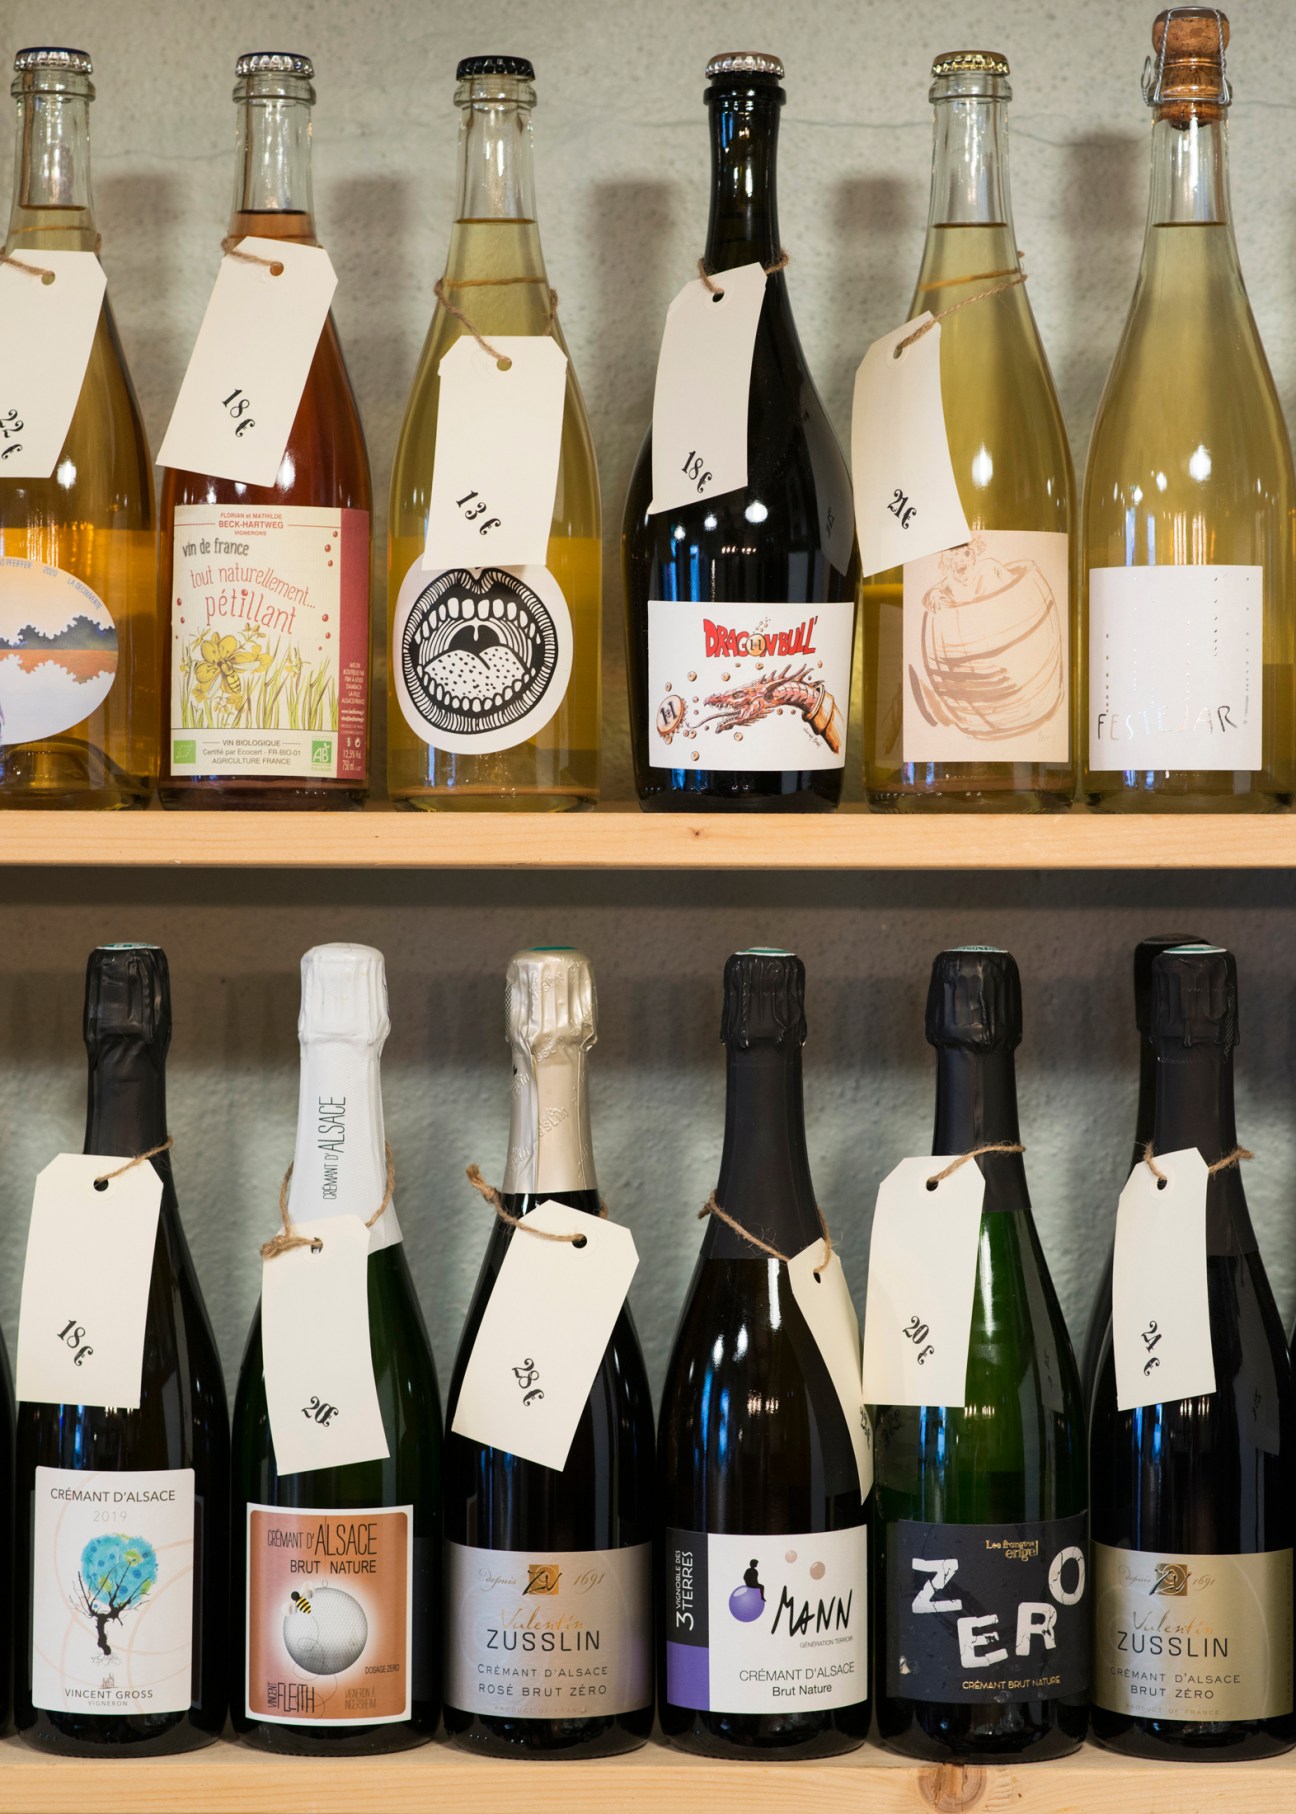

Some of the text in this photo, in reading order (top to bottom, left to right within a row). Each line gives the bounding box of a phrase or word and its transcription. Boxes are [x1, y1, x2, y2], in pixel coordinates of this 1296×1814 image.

[222, 389, 255, 437] 18€
[681, 450, 712, 493] 18€
[456, 490, 501, 535] 13€
[887, 489, 917, 529] 21€
[219, 520, 284, 529] BECK-HARTWEG
[182, 538, 249, 557] vin de france
[190, 566, 214, 588] tout
[205, 588, 296, 634] pétillant
[322, 1164, 338, 1200] CRÉMANT
[57, 1320, 93, 1366] 18€
[903, 1316, 934, 1365] 20€
[512, 1358, 544, 1406] 28€
[301, 1396, 339, 1427] 20€
[51, 1488, 175, 1502] CRÉMANT D'ALSACE
[93, 1510, 127, 1522] 2019
[268, 1528, 303, 1549] CRÉMANT
[290, 1560, 376, 1574] BRUT NATURE
[682, 1551, 693, 1610] TERRES
[771, 1585, 853, 1637] MANN
[912, 1546, 1086, 1668] ZERO
[486, 1629, 600, 1651] ZUSSLIN
[1117, 1631, 1228, 1657] ZUSSLIN
[365, 1665, 386, 1674] DOSAGE
[477, 1664, 608, 1678] CRÉMANT D'ALSACE
[739, 1662, 855, 1682] CRÉMANT D'ALSACE
[1110, 1666, 1241, 1684] CRÉMANT D'ALSACE
[65, 1688, 153, 1699] VINCENT GROSS
[478, 1683, 607, 1697] ROSÉ BRUT ZÉRO
[772, 1684, 832, 1696] Brut Nature
[962, 1675, 1061, 1690] CRÉMANT BRUT NATURE
[1130, 1685, 1214, 1699] BRUT ZÉRO
[268, 1682, 277, 1708] VINCENT
